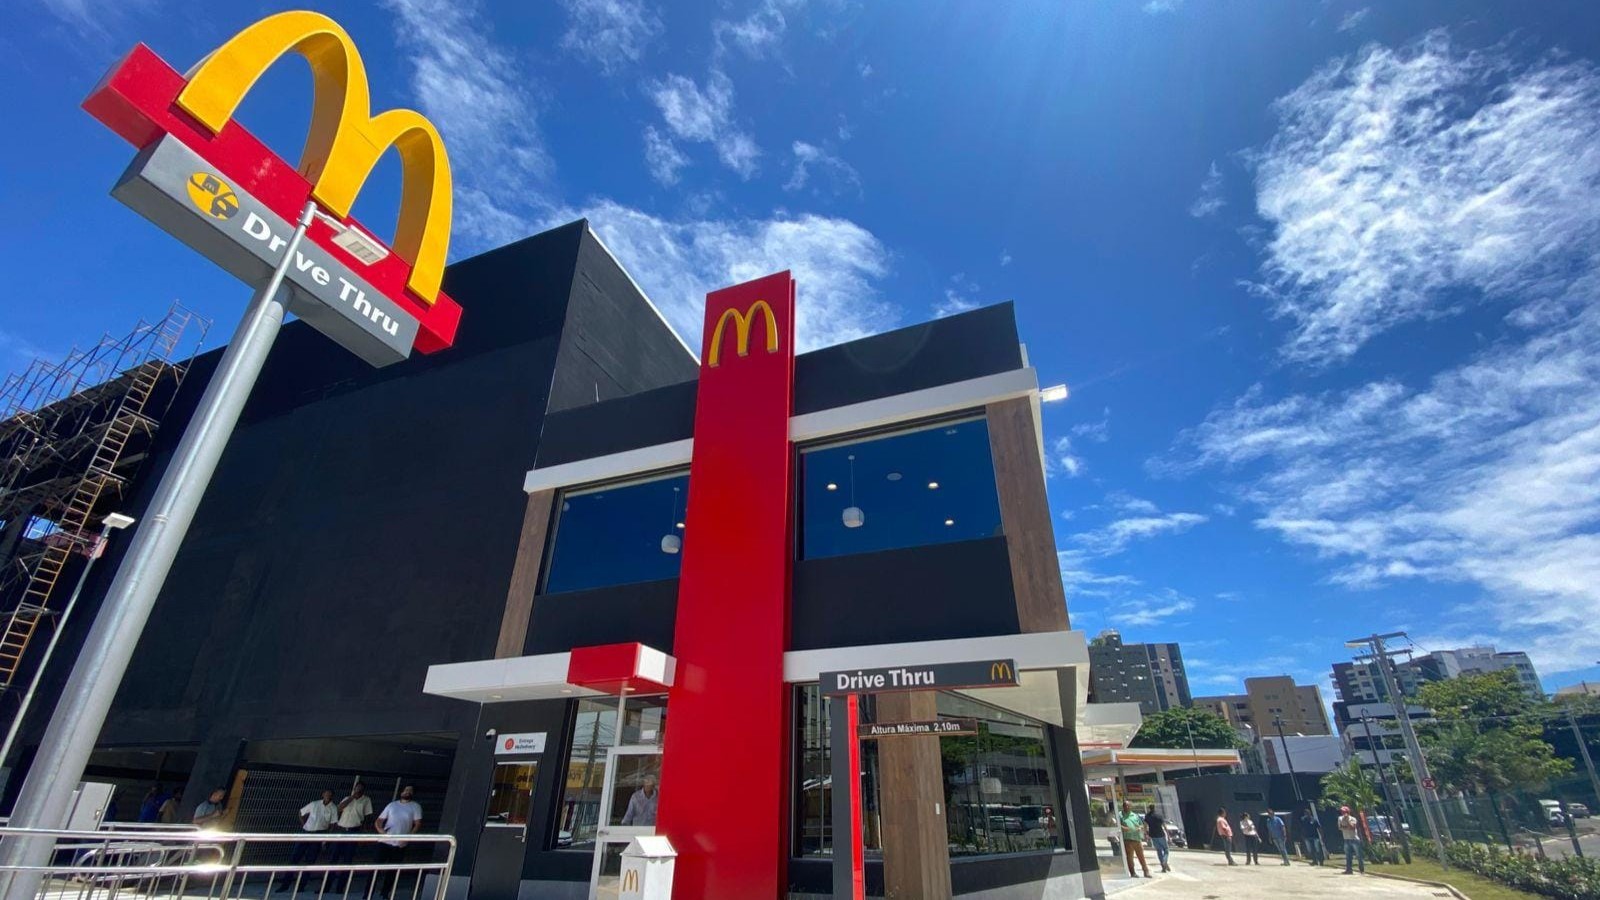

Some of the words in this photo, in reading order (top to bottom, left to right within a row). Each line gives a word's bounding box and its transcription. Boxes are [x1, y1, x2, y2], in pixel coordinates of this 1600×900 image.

[242, 212, 330, 285] Drve
[338, 276, 399, 335] Thru
[836, 671, 885, 690] Drive
[888, 669, 935, 687] Thru
[871, 725, 896, 735] Altura
[897, 723, 930, 733] Máxima
[933, 722, 961, 733] 2,10m
